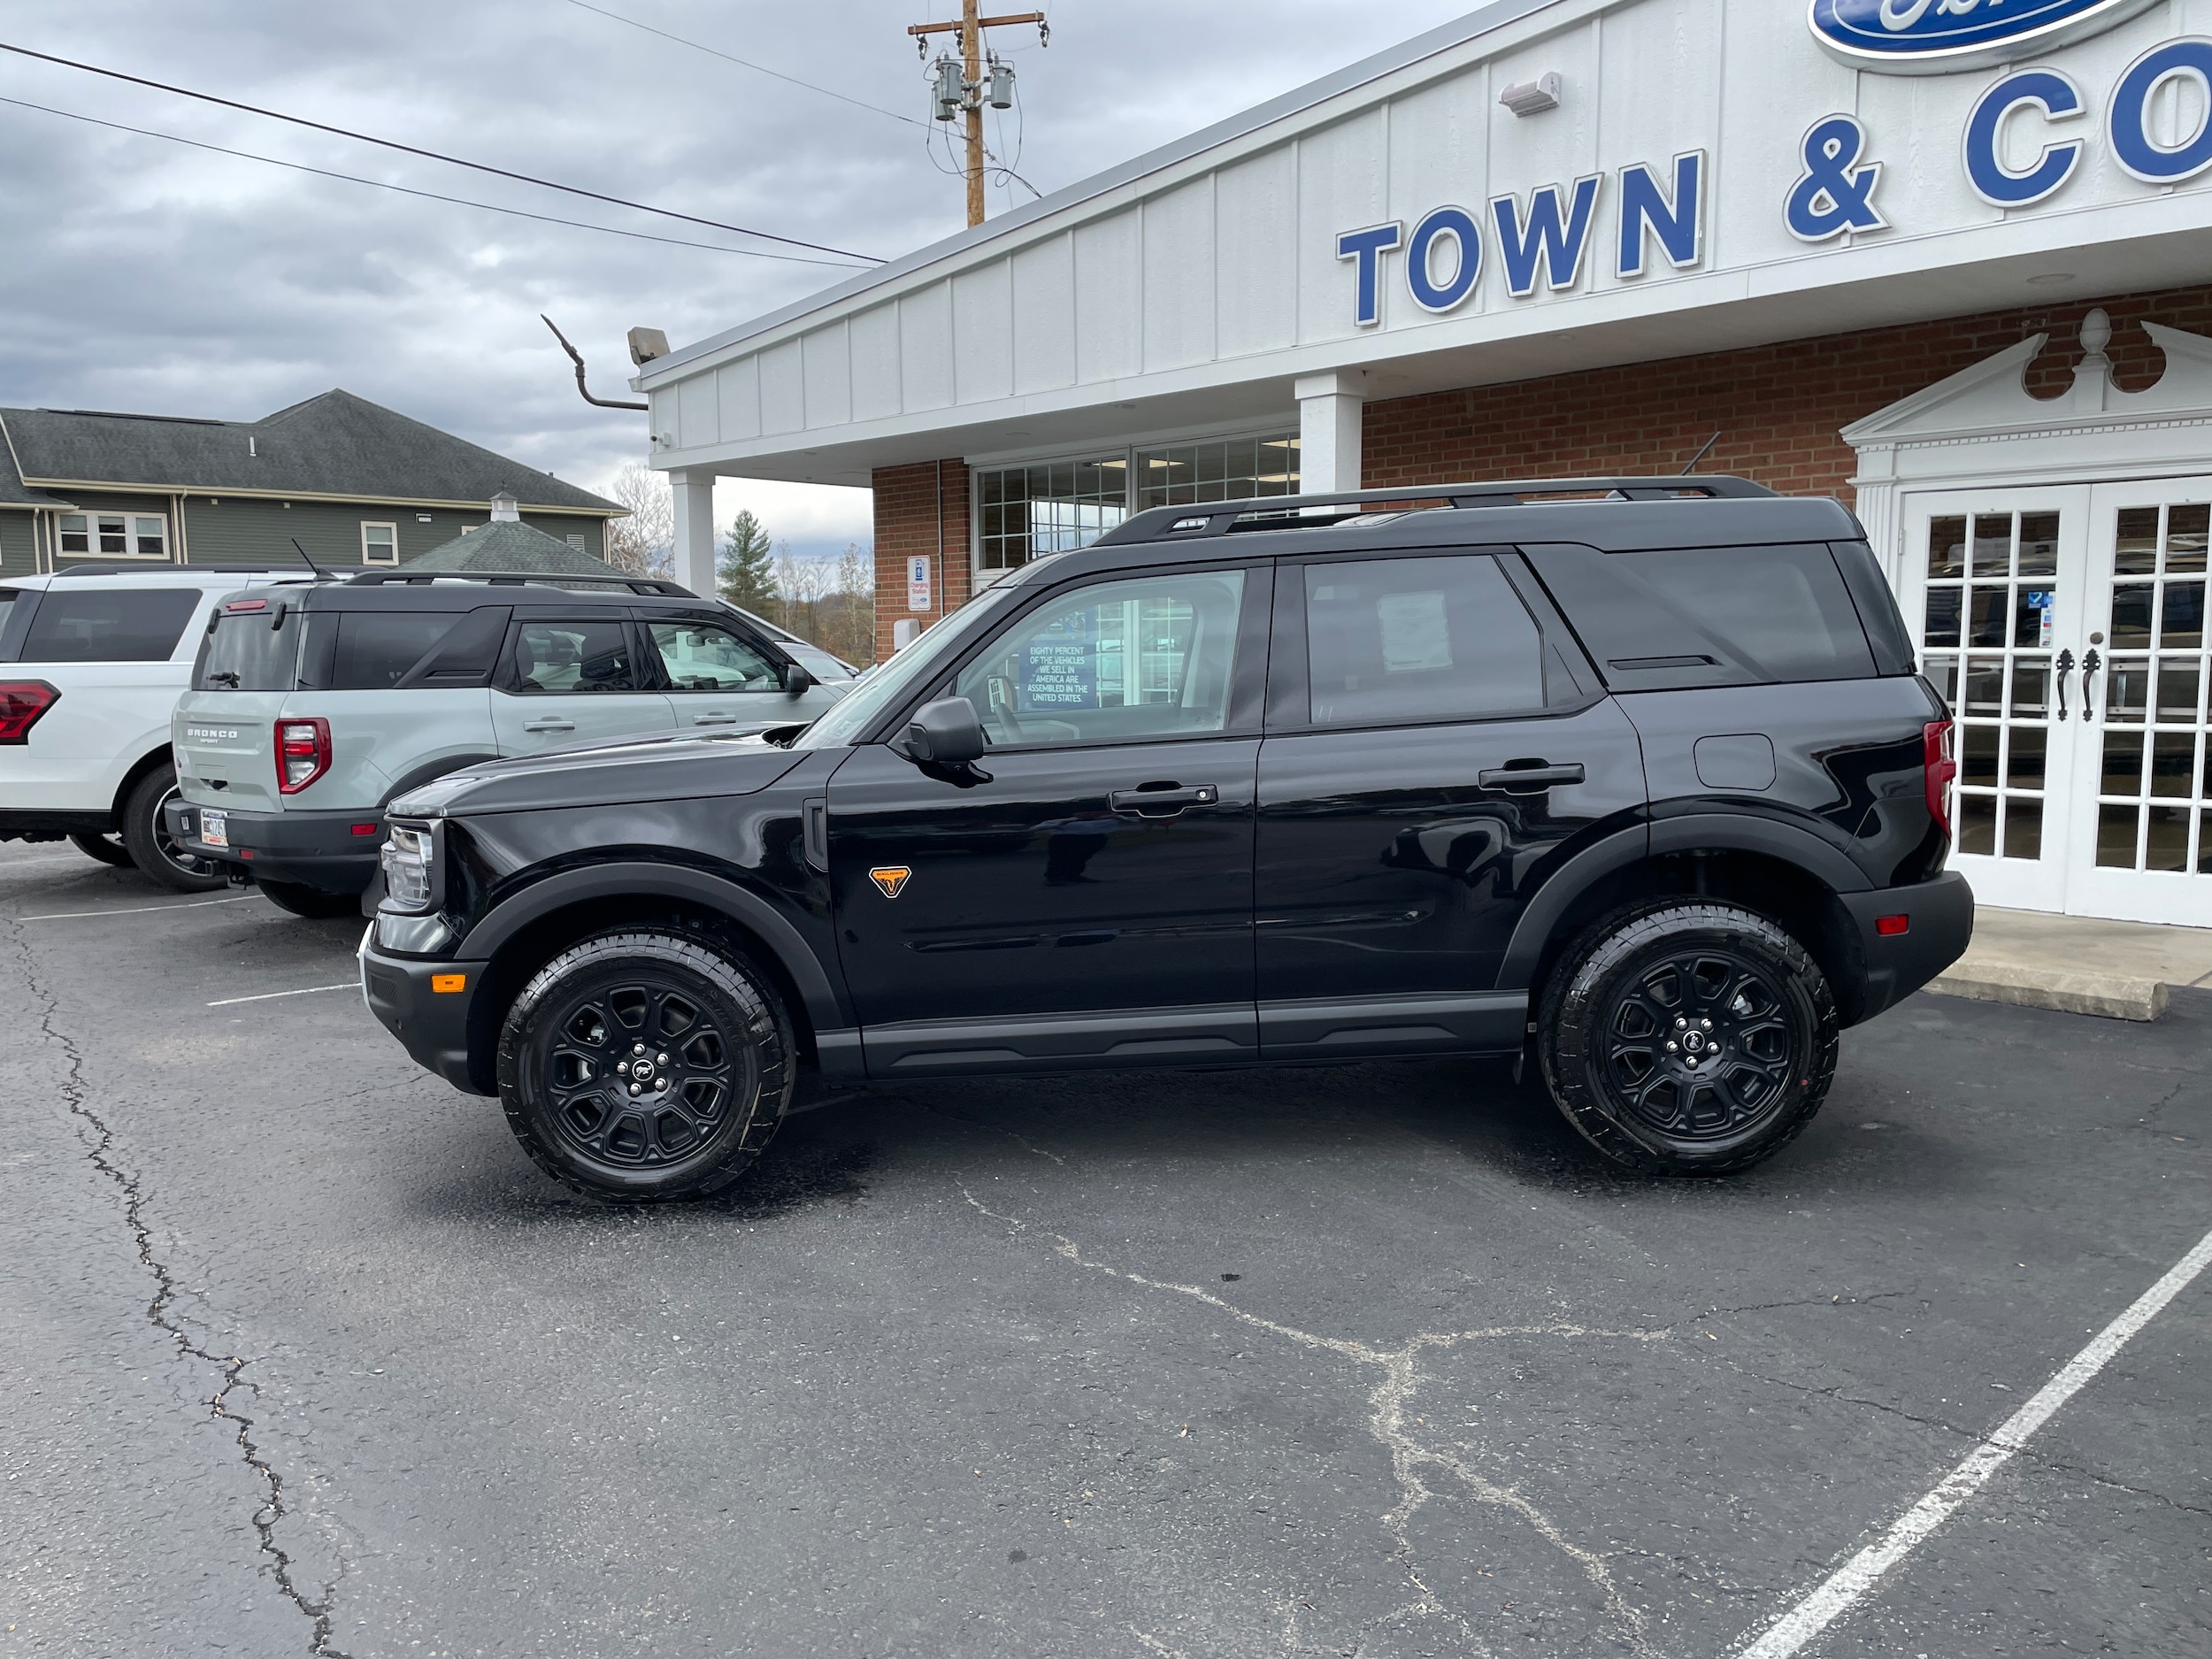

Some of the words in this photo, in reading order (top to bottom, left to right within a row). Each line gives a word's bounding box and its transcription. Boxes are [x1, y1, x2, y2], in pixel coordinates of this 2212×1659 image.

[1335, 148, 1707, 327] TOWN
[1784, 112, 1892, 242] &
[1065, 675, 1079, 684] ARE
[1027, 684, 1064, 693] ASSEMBLED
[1032, 693, 1056, 702] UNITED
[1057, 694, 1083, 703] STATES.
[187, 728, 238, 739] BRONCO
